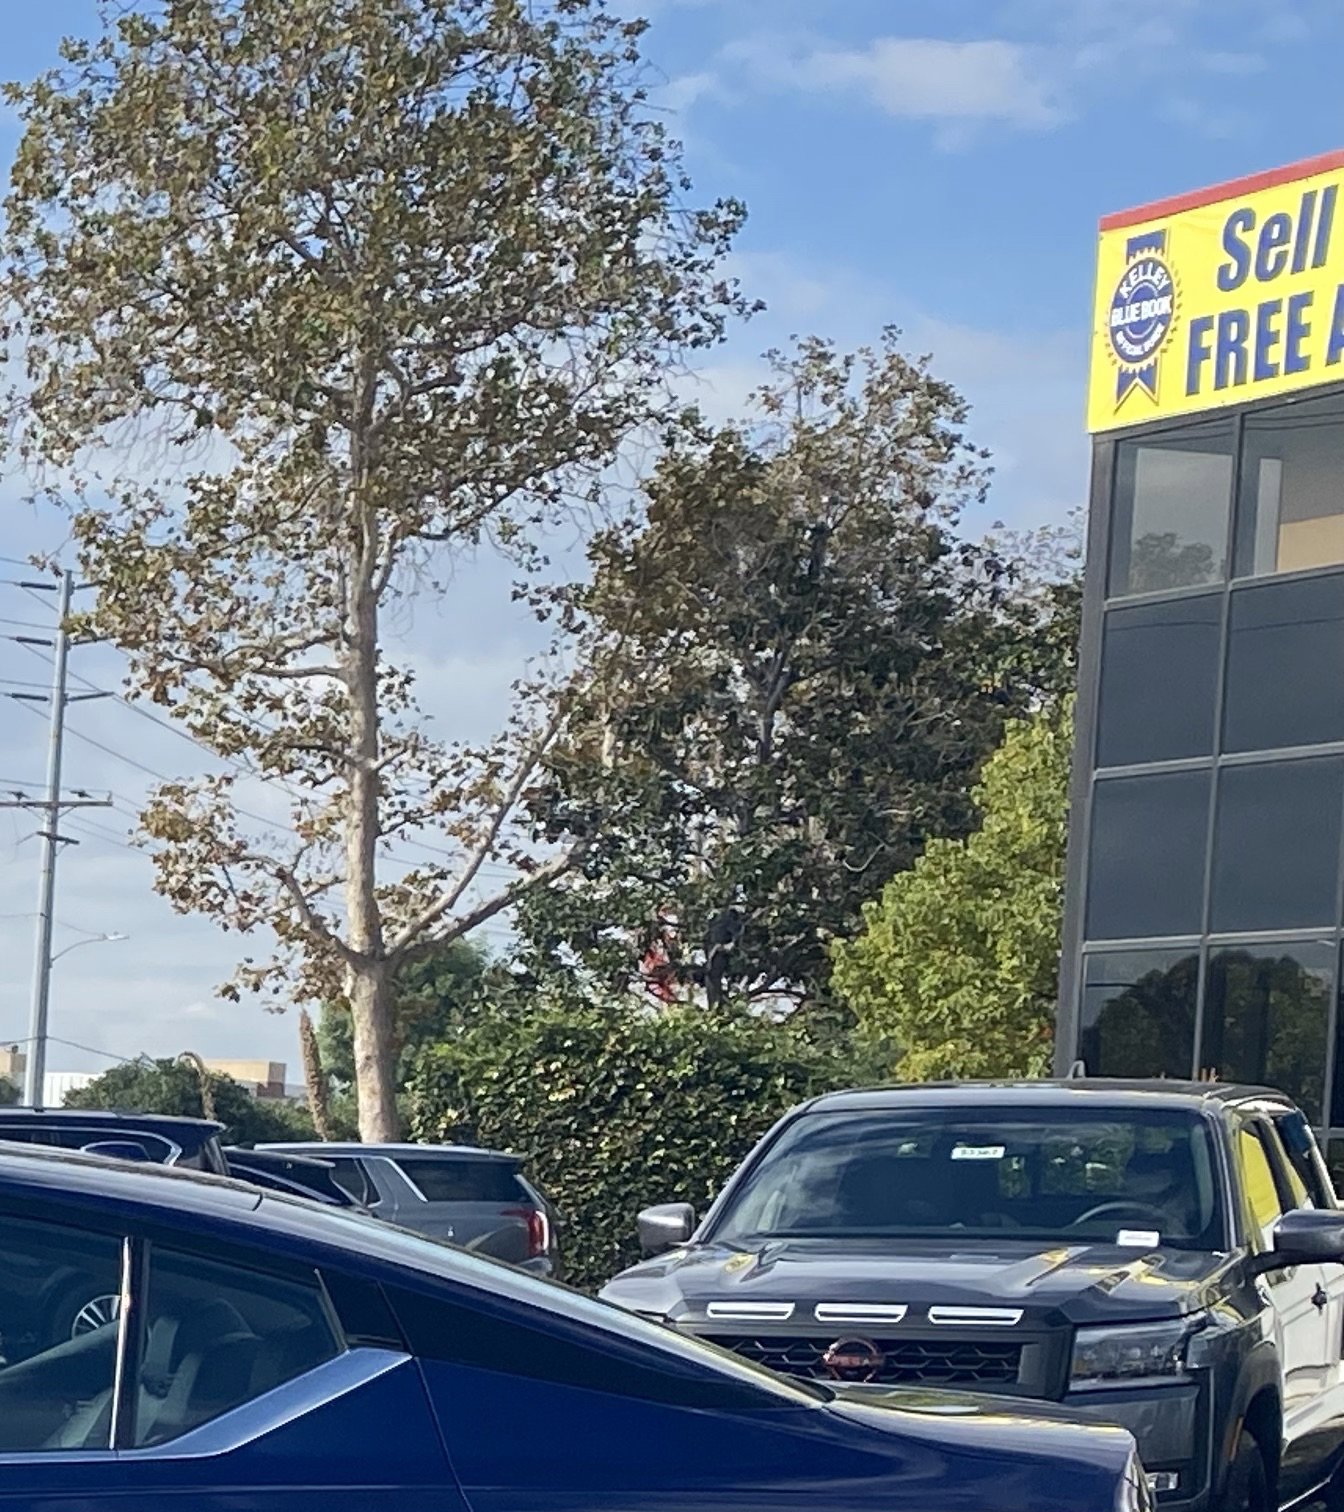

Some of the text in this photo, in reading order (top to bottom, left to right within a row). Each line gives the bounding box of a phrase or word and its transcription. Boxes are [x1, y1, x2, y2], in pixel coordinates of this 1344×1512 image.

[1119, 261, 1171, 299] KELLEY
[1217, 184, 1338, 292] Sell
[1185, 290, 1315, 397] FREE
